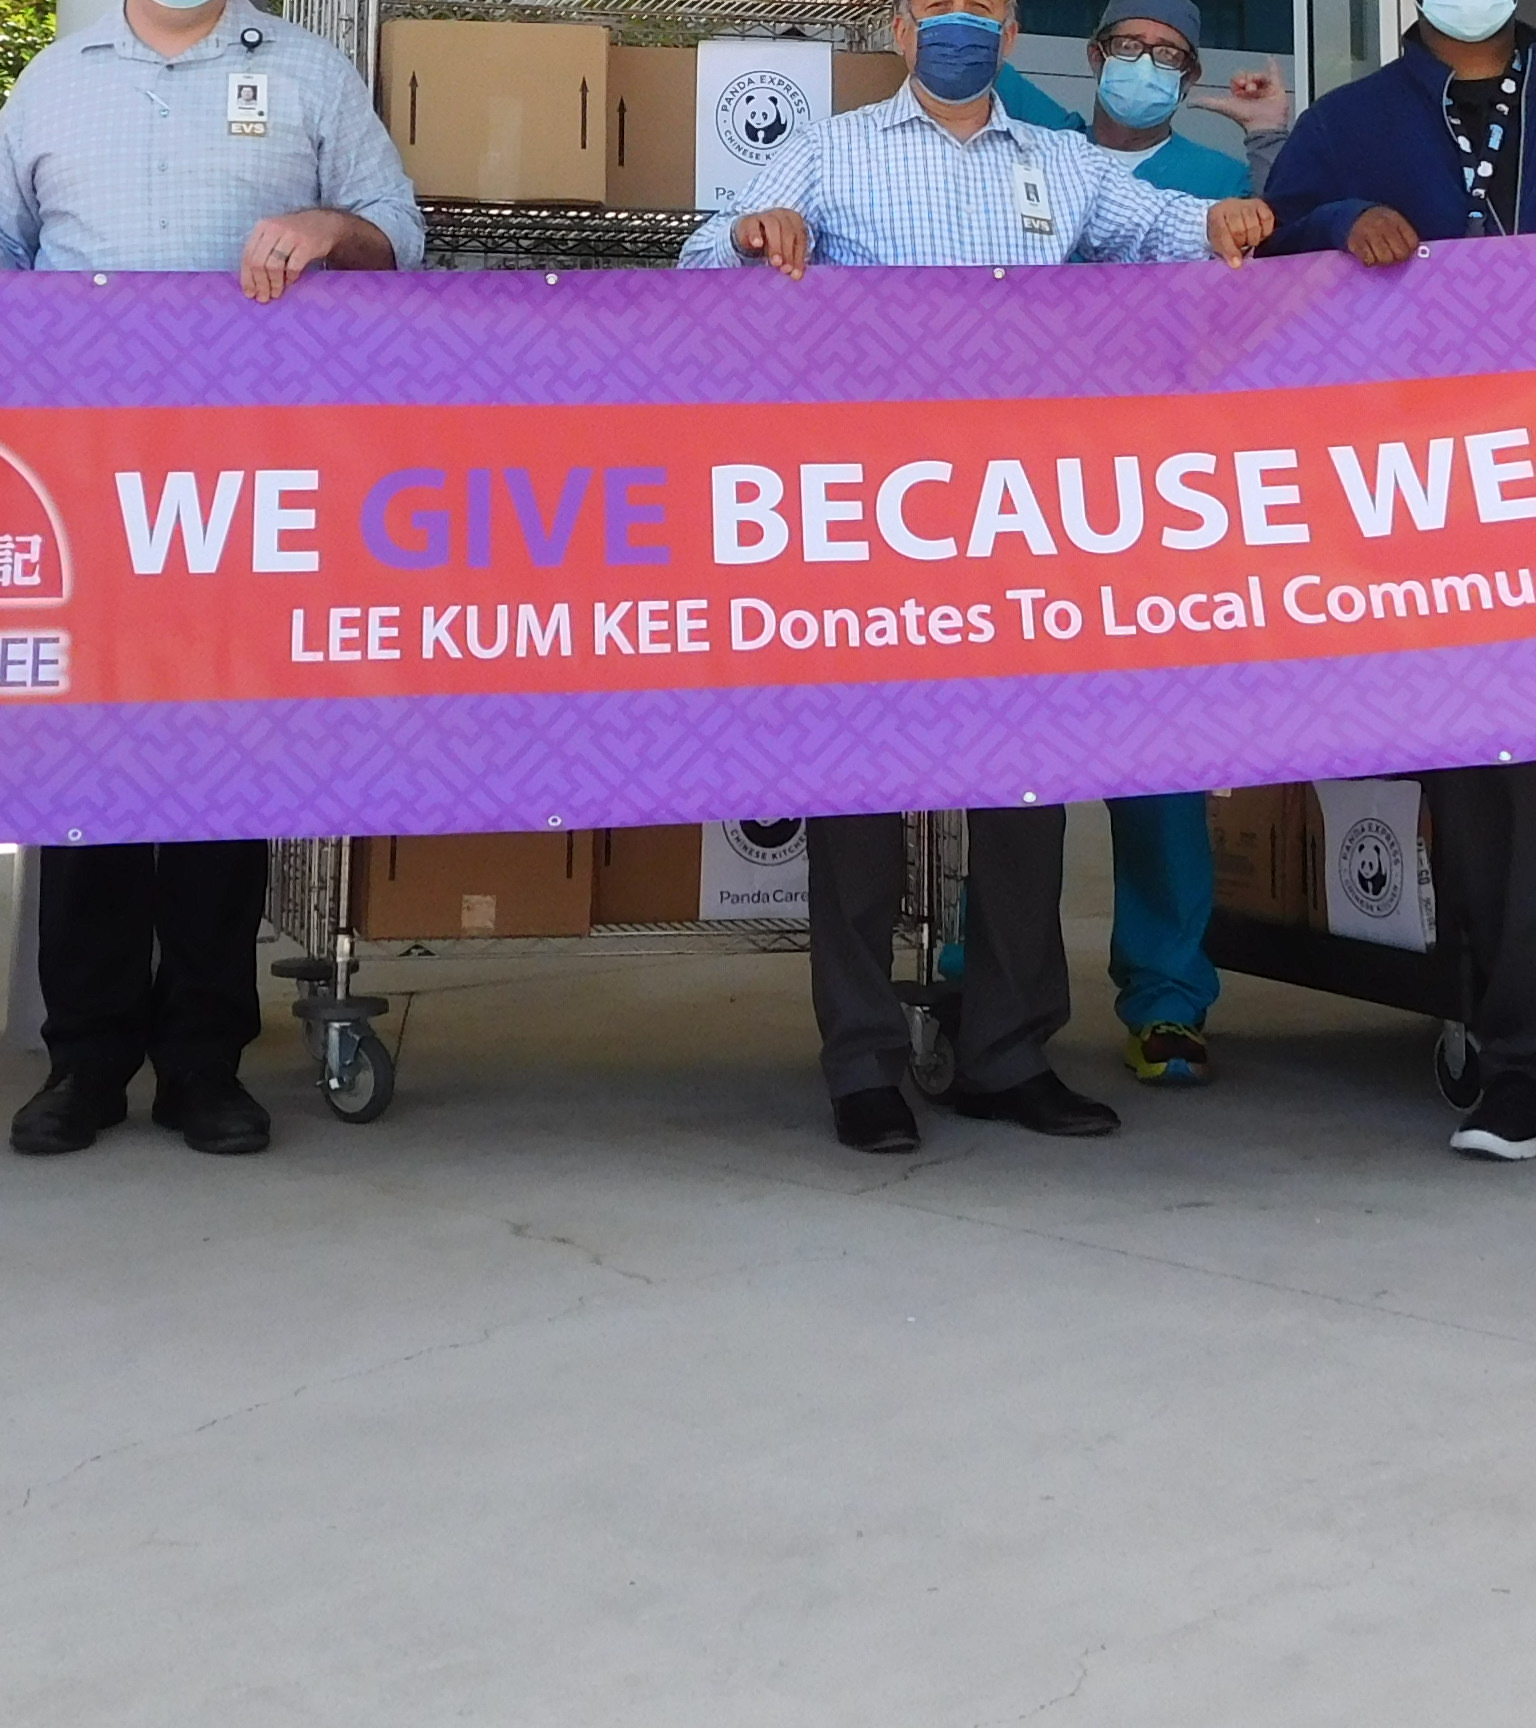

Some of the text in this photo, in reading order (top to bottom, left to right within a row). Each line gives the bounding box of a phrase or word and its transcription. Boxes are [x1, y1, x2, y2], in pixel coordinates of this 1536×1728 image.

[721, 75, 806, 115] PANDA EXPRESS
[231, 123, 265, 134] EVS
[724, 129, 761, 160] CHINESE
[115, 470, 319, 574] WE
[358, 466, 671, 570] GIVE
[711, 449, 1311, 564] BECAUSE
[291, 606, 401, 662] LEE
[421, 603, 572, 660] KUM
[593, 599, 710, 656] KEE
[730, 597, 996, 652] Donates
[1005, 588, 1083, 640] To
[1100, 575, 1267, 636] Local
[730, 828, 807, 860] CHINESE KITCHE
[720, 890, 770, 904] Panda
